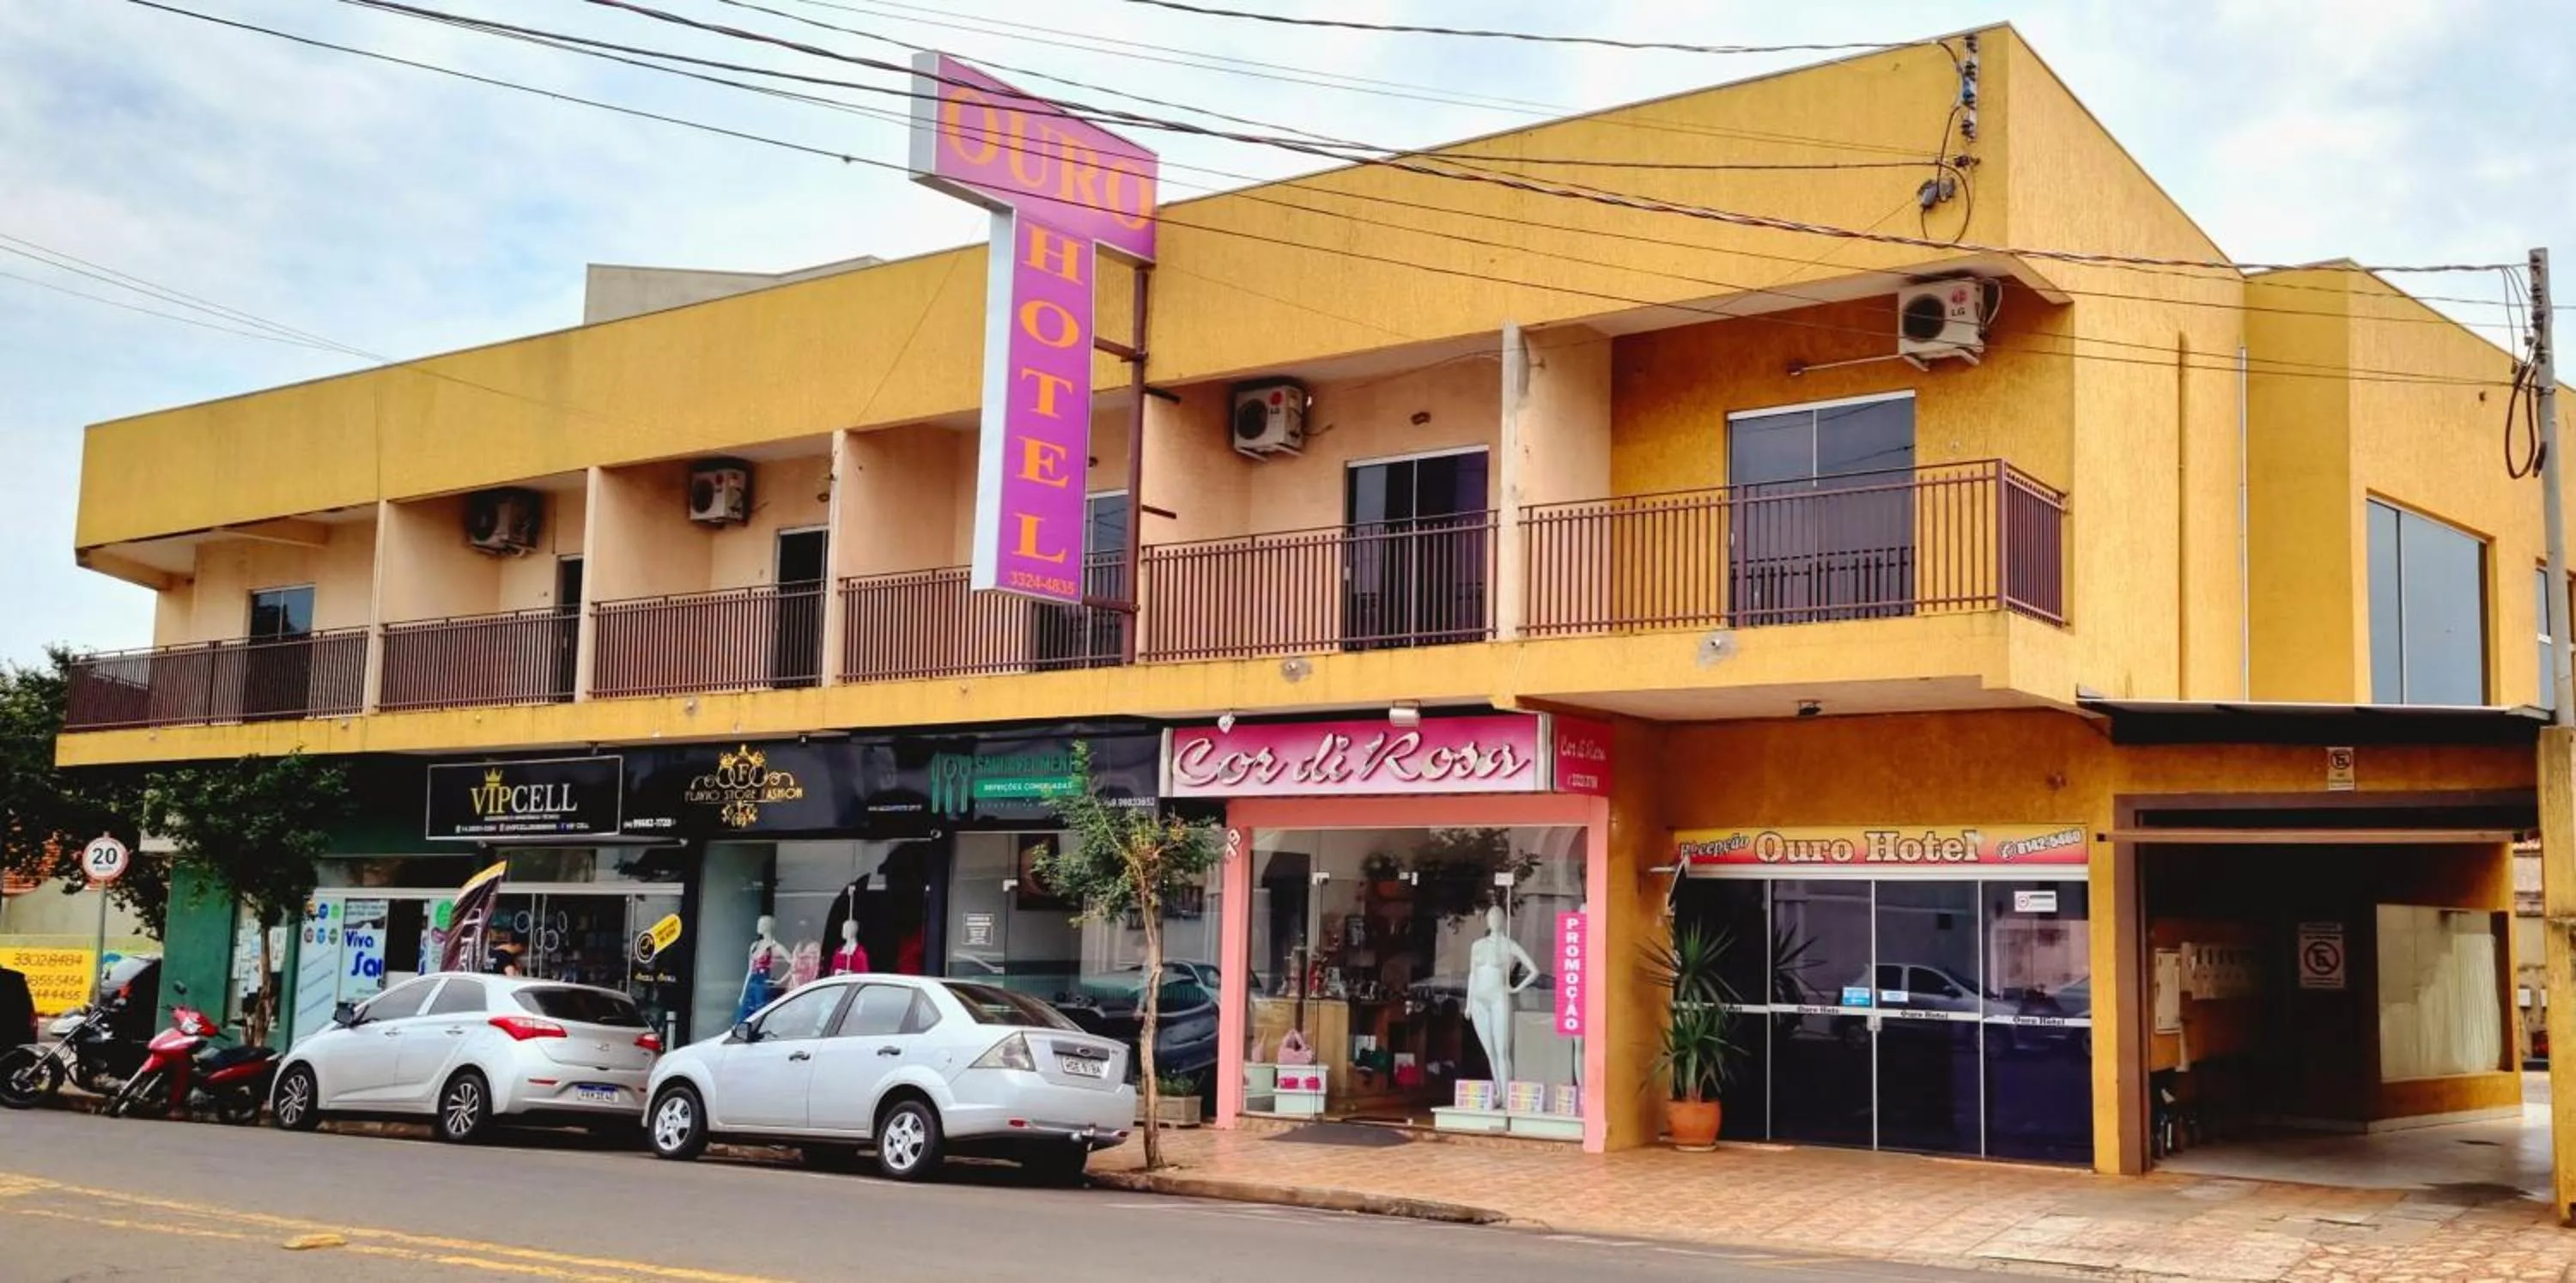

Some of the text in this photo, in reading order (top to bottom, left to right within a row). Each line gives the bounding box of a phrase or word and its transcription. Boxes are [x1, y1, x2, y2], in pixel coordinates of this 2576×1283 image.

[945, 88, 1154, 232] OURO
[1951, 307, 1965, 317] LG
[1011, 222, 1085, 565] HOTEL
[1173, 731, 1532, 787] Cor di Rosa
[470, 782, 578, 816] VIPCELL
[92, 848, 118, 865] 20
[1754, 830, 1856, 864] Ouro
[1864, 830, 1979, 864] Hotel
[345, 931, 374, 948] Viva
[1564, 916, 1581, 1031] PROMOÇÃO
